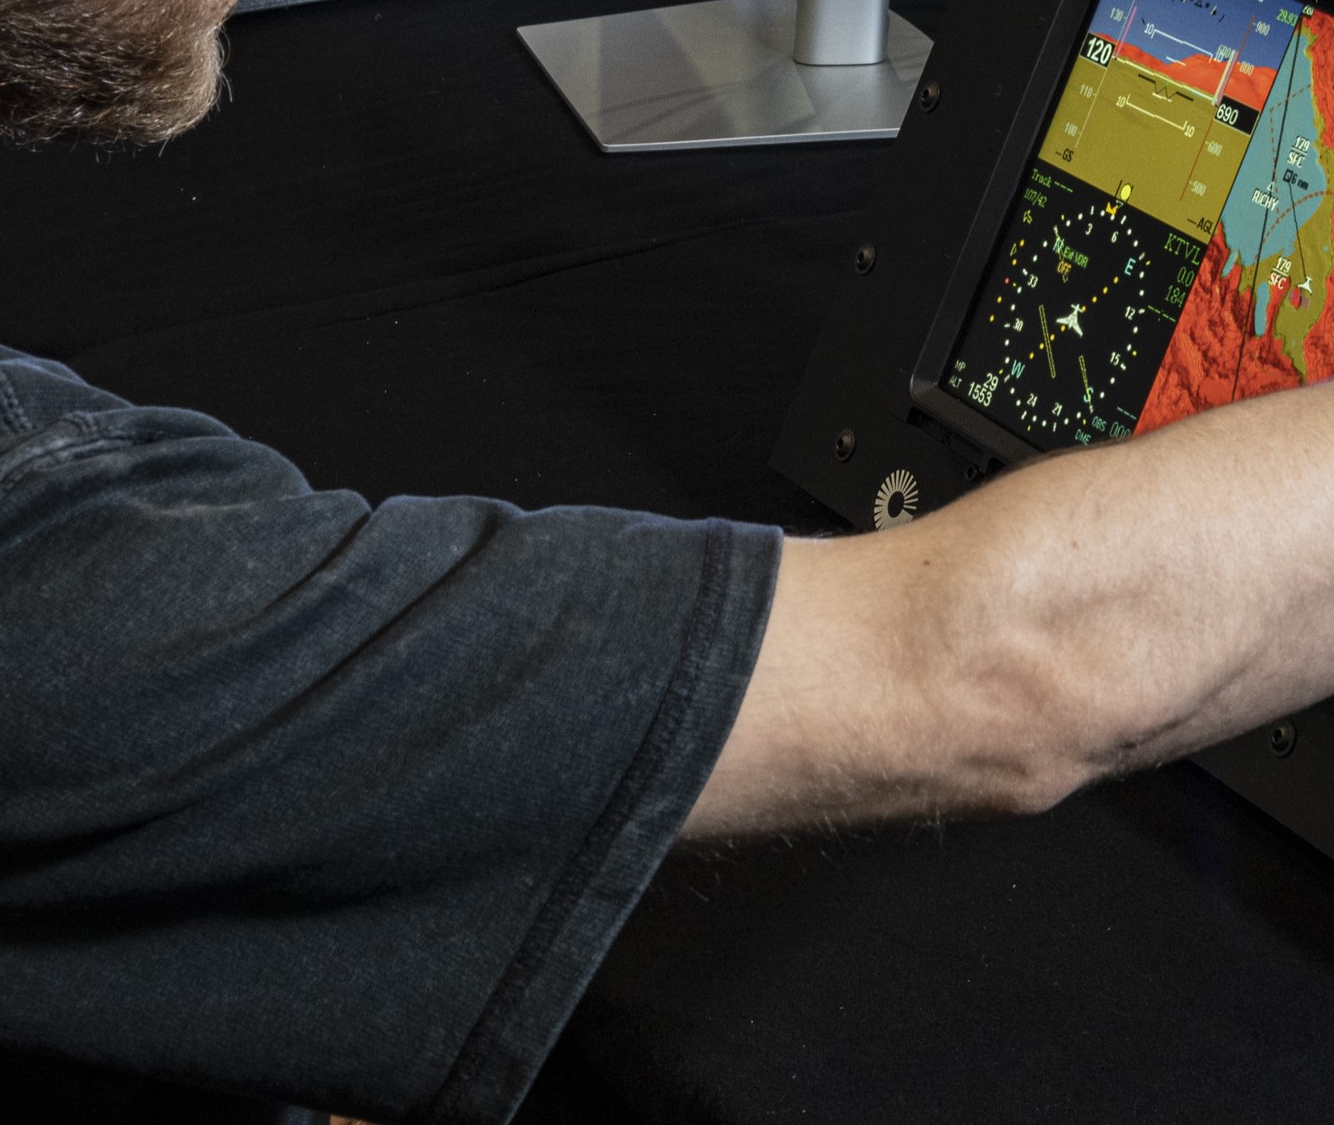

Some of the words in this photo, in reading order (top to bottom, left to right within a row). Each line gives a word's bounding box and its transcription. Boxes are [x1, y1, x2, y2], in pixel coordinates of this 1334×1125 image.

[1109, 8, 1124, 22] 130
[1144, 24, 1154, 35] 10
[1087, 39, 1111, 65] 120
[1116, 96, 1126, 108] 10
[1216, 104, 1239, 126] 690
[1184, 125, 1195, 138] 10
[1295, 135, 1310, 151] 179
[1287, 152, 1305, 169] SFC
[1031, 168, 1052, 188] Track
[1085, 223, 1093, 235] 3
[1196, 216, 1213, 235] AGL
[1110, 231, 1119, 243] 6
[1163, 233, 1201, 266] KTVL
[1124, 257, 1136, 275] E
[1276, 256, 1292, 273] 179
[1027, 275, 1039, 288] 33
[1176, 266, 1195, 287] 0.0
[1268, 272, 1288, 290] SFC
[1164, 284, 1186, 308] 184
[1124, 306, 1136, 320] 12
[1012, 319, 1024, 332] 30
[954, 360, 966, 371] MP
[1110, 352, 1121, 366] 15
[1011, 358, 1025, 379] W
[948, 375, 962, 389] ALT
[983, 373, 999, 391] 29
[968, 382, 993, 407] 1553
[1026, 393, 1038, 407] 24
[1052, 403, 1063, 416] 21
[1075, 428, 1091, 445] DME
